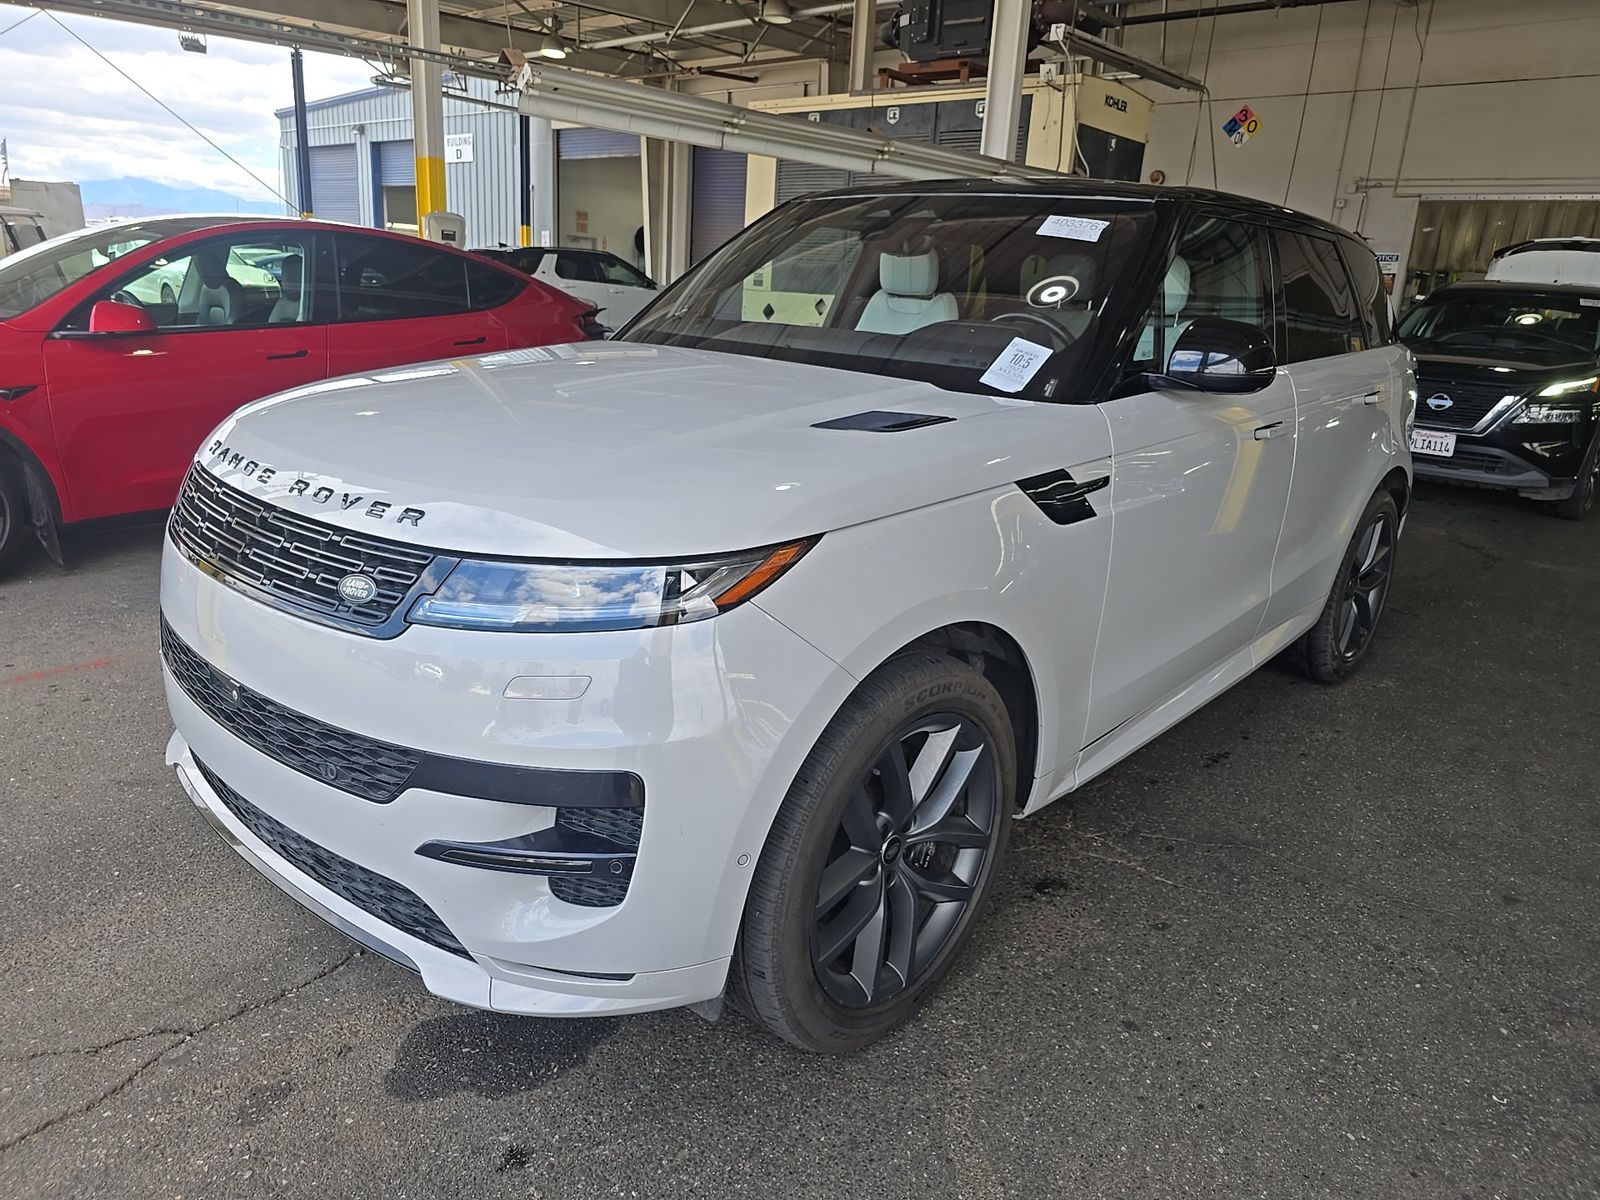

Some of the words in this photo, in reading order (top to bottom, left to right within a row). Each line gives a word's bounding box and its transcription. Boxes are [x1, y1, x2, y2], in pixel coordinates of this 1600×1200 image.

[1104, 94, 1128, 113] KOHLER
[1238, 109, 1249, 123] 3
[1229, 119, 1238, 132] 2
[1247, 119, 1258, 133] 0
[447, 136, 471, 147] BUILDING
[456, 148, 462, 159] D
[1375, 254, 1398, 262] OTICE
[208, 439, 277, 485] RANGE
[288, 478, 426, 527] ROVER
[345, 579, 366, 589] LAND
[344, 586, 368, 598] ROVER
[903, 680, 987, 713] SCORPION
